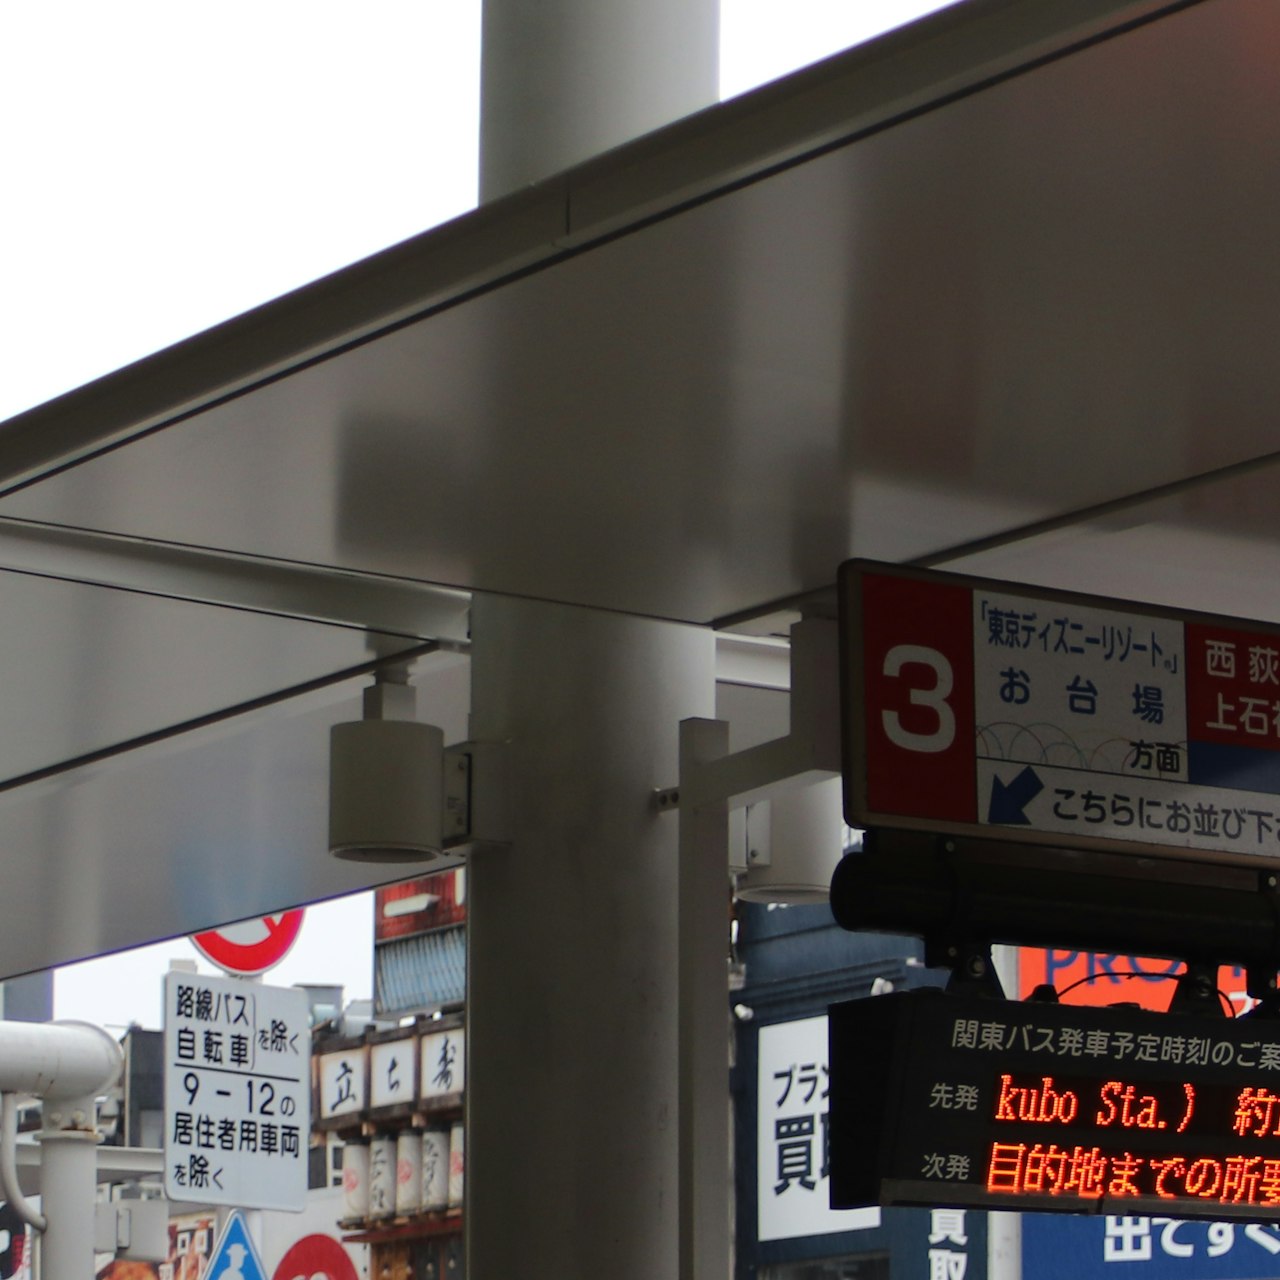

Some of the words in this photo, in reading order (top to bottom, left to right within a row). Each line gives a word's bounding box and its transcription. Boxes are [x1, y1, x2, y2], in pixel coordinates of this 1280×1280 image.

[882, 644, 956, 752] 3
[999, 667, 1164, 724] お台場
[1130, 739, 1180, 773] 方面
[177, 985, 249, 1026] 路線バス
[178, 1028, 249, 1067] 自転車
[257, 1020, 300, 1054] を除く
[930, 1083, 978, 1111] 先発
[995, 1075, 1077, 1124] kubo
[174, 1112, 300, 1159] 居住者用車両
[773, 1114, 830, 1194] 買
[174, 1154, 224, 1190] を除く
[921, 1153, 970, 1181] 次発
